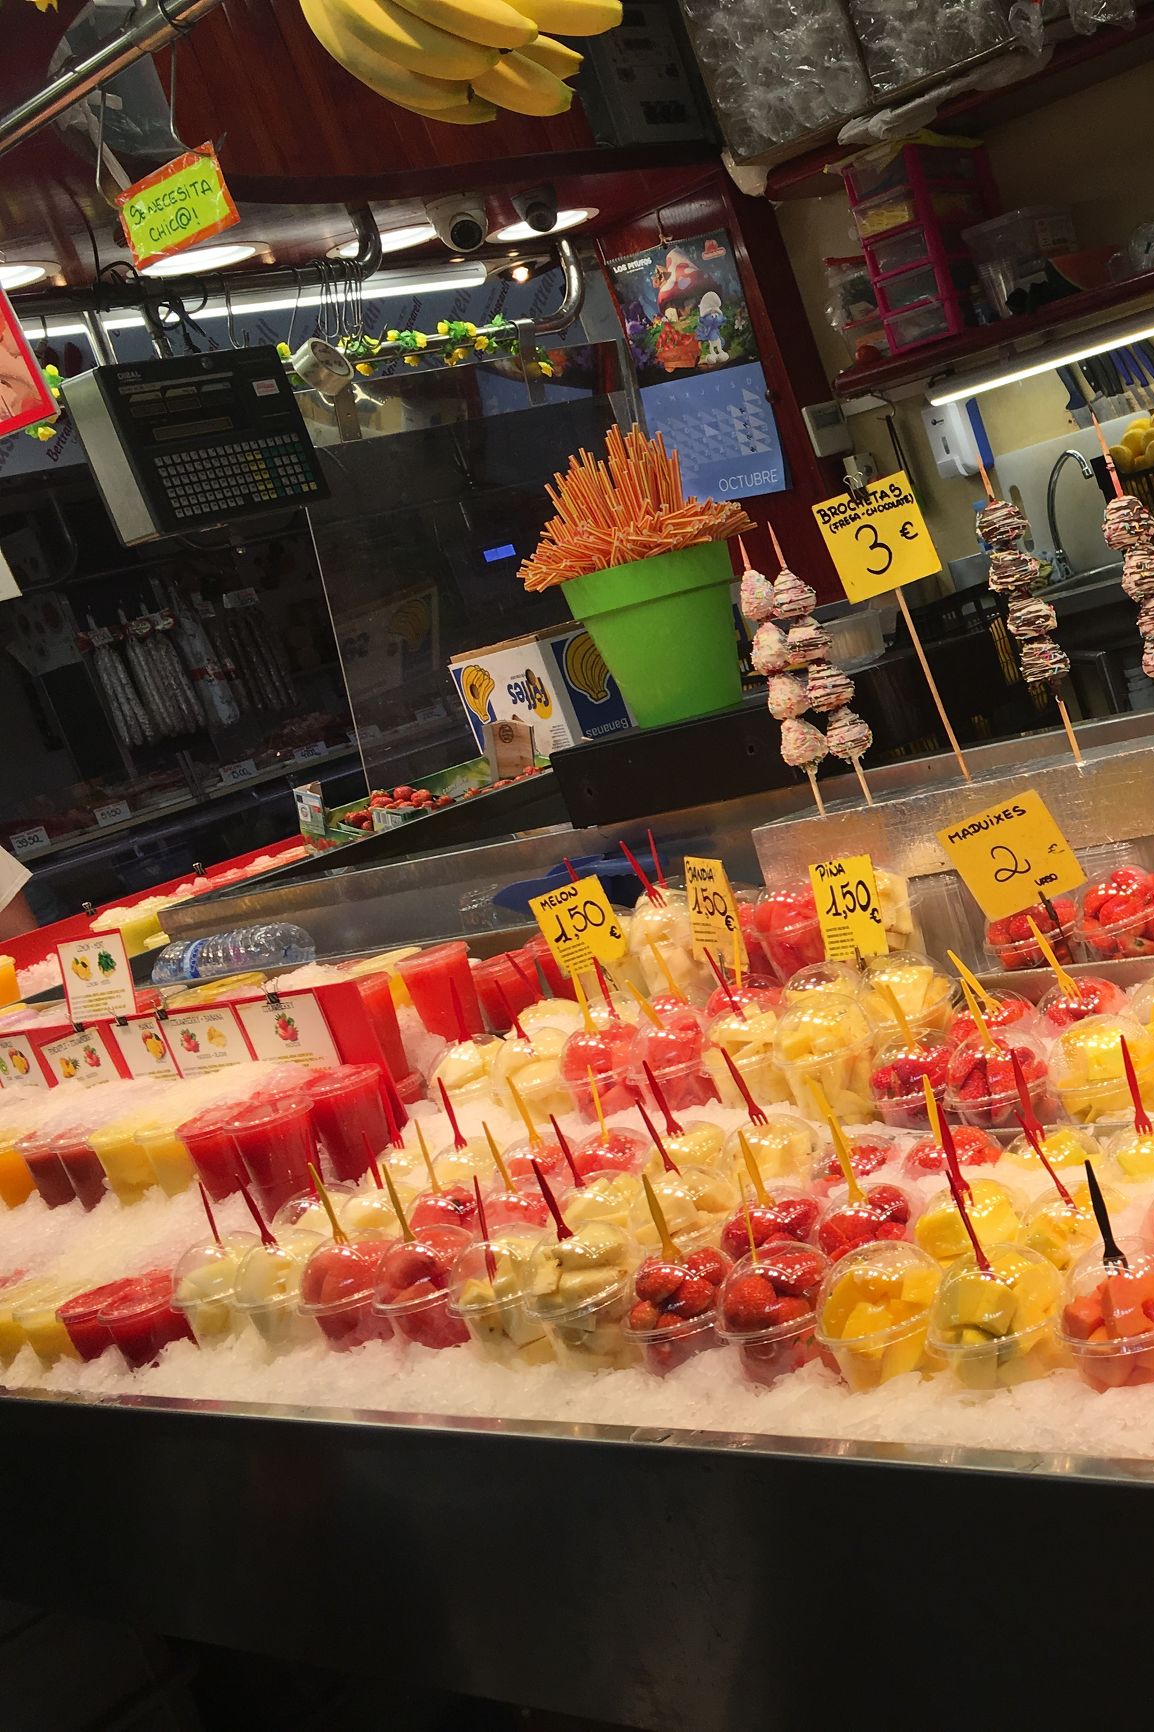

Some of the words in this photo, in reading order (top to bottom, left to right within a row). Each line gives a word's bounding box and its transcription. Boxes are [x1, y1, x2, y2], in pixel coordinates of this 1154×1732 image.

[718, 468, 778, 492] OCTUBRE
[854, 524, 893, 576] 3
[900, 520, 919, 540] €
[586, 718, 630, 738] Bananas
[990, 845, 1032, 883] 2
[540, 886, 578, 912] MELON
[692, 886, 728, 920] 1,50
[724, 914, 737, 932] €
[826, 880, 871, 920] 1,50
[869, 908, 882, 924] €
[554, 900, 606, 944] 1,50
[609, 926, 622, 940] €
